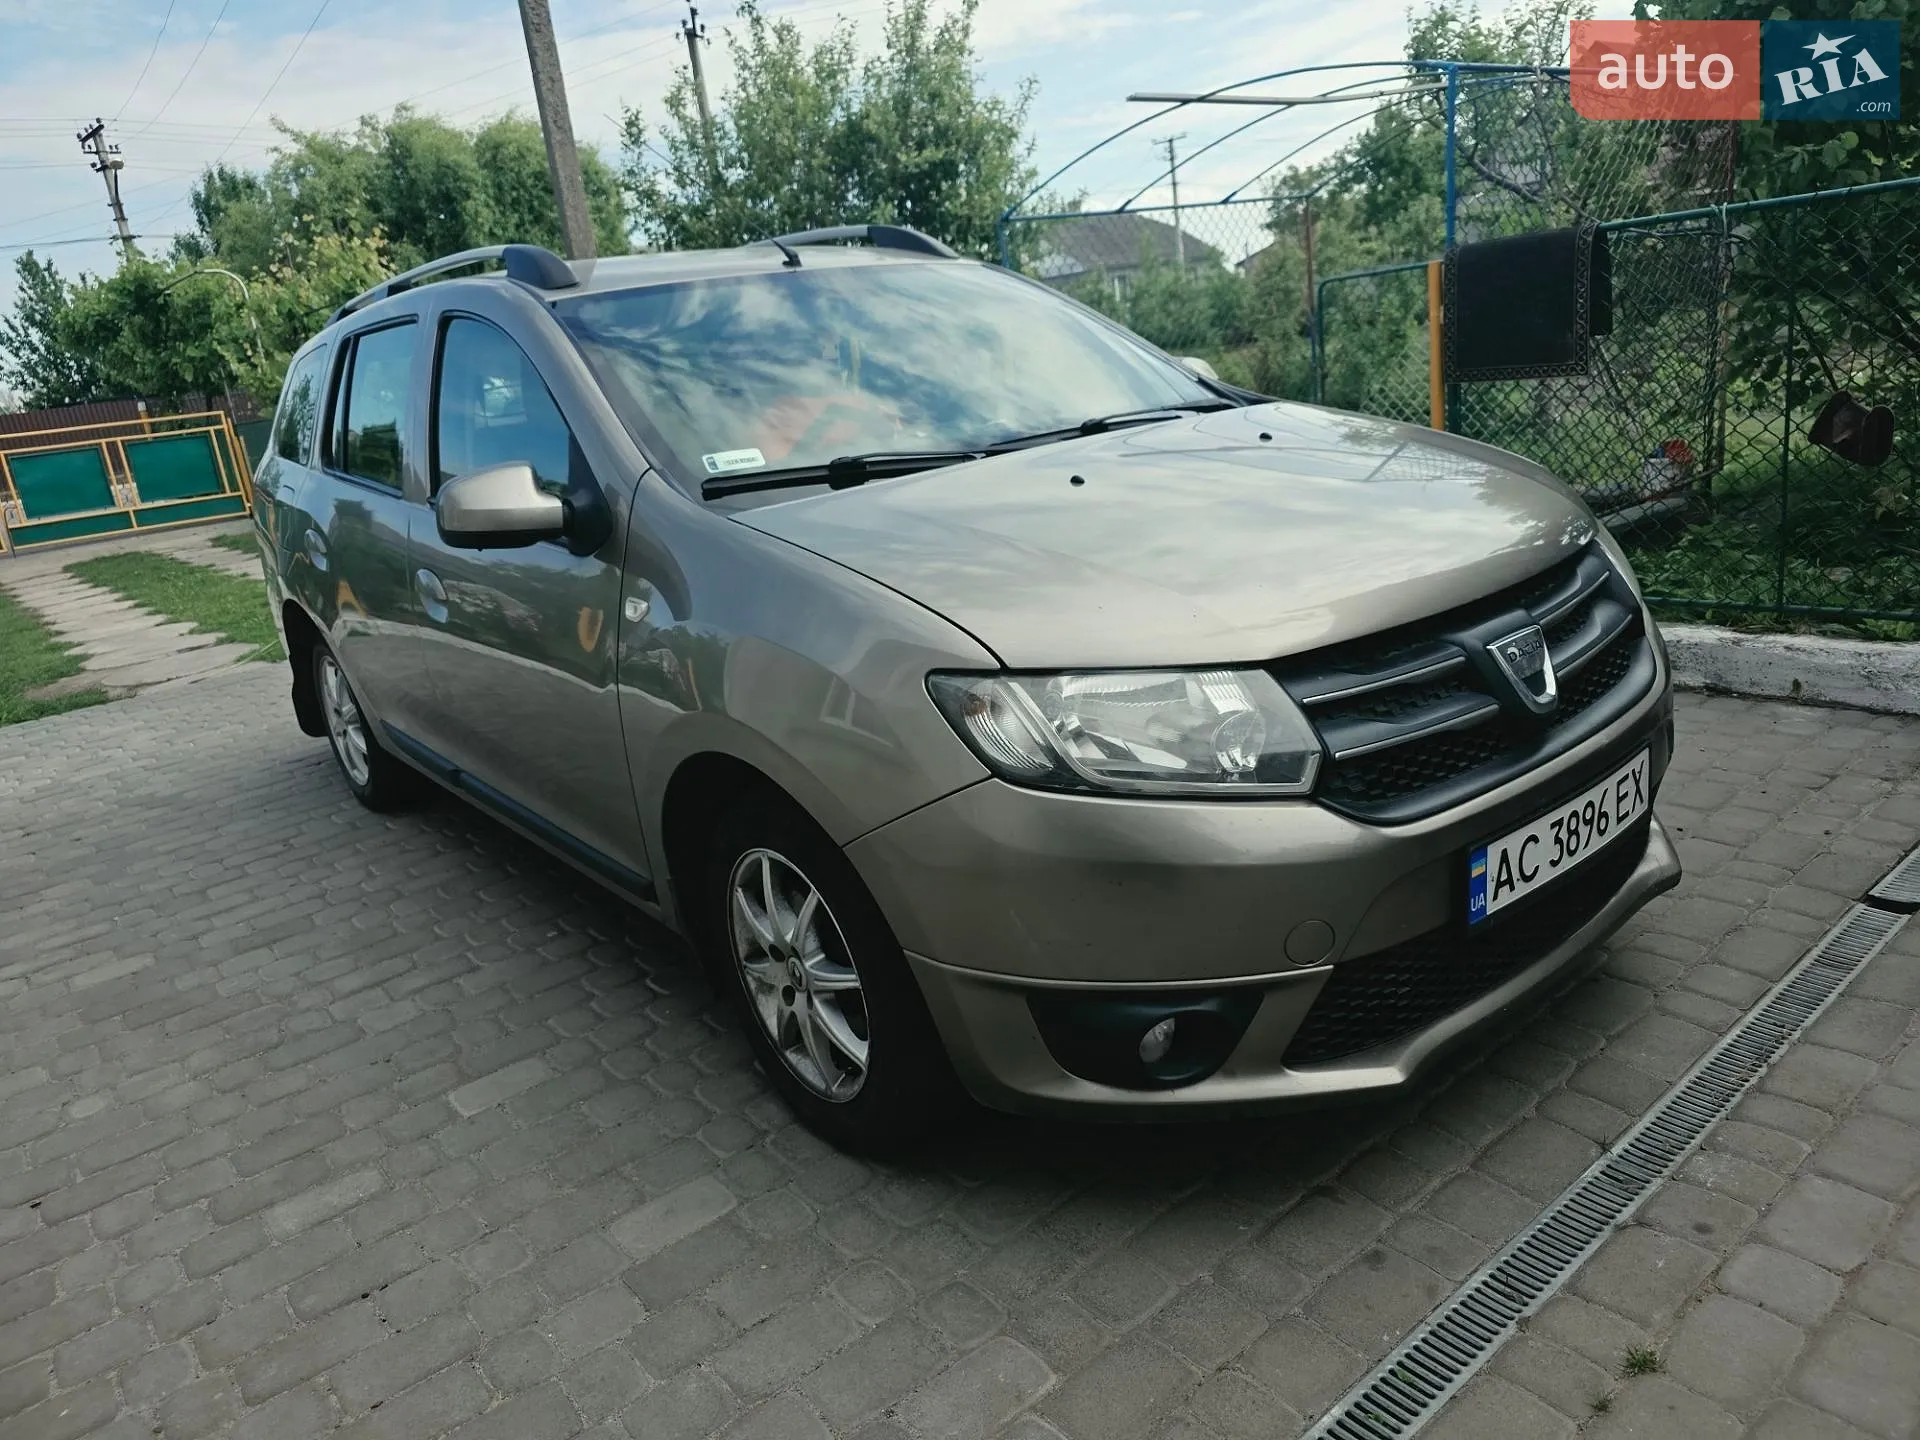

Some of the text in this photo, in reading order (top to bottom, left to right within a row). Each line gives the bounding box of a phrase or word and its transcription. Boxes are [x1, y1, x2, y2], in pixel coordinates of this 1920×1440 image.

[1507, 640, 1544, 663] DACIA
[1492, 759, 1645, 902] AC 3896 EX
[1470, 892, 1486, 912] UA
